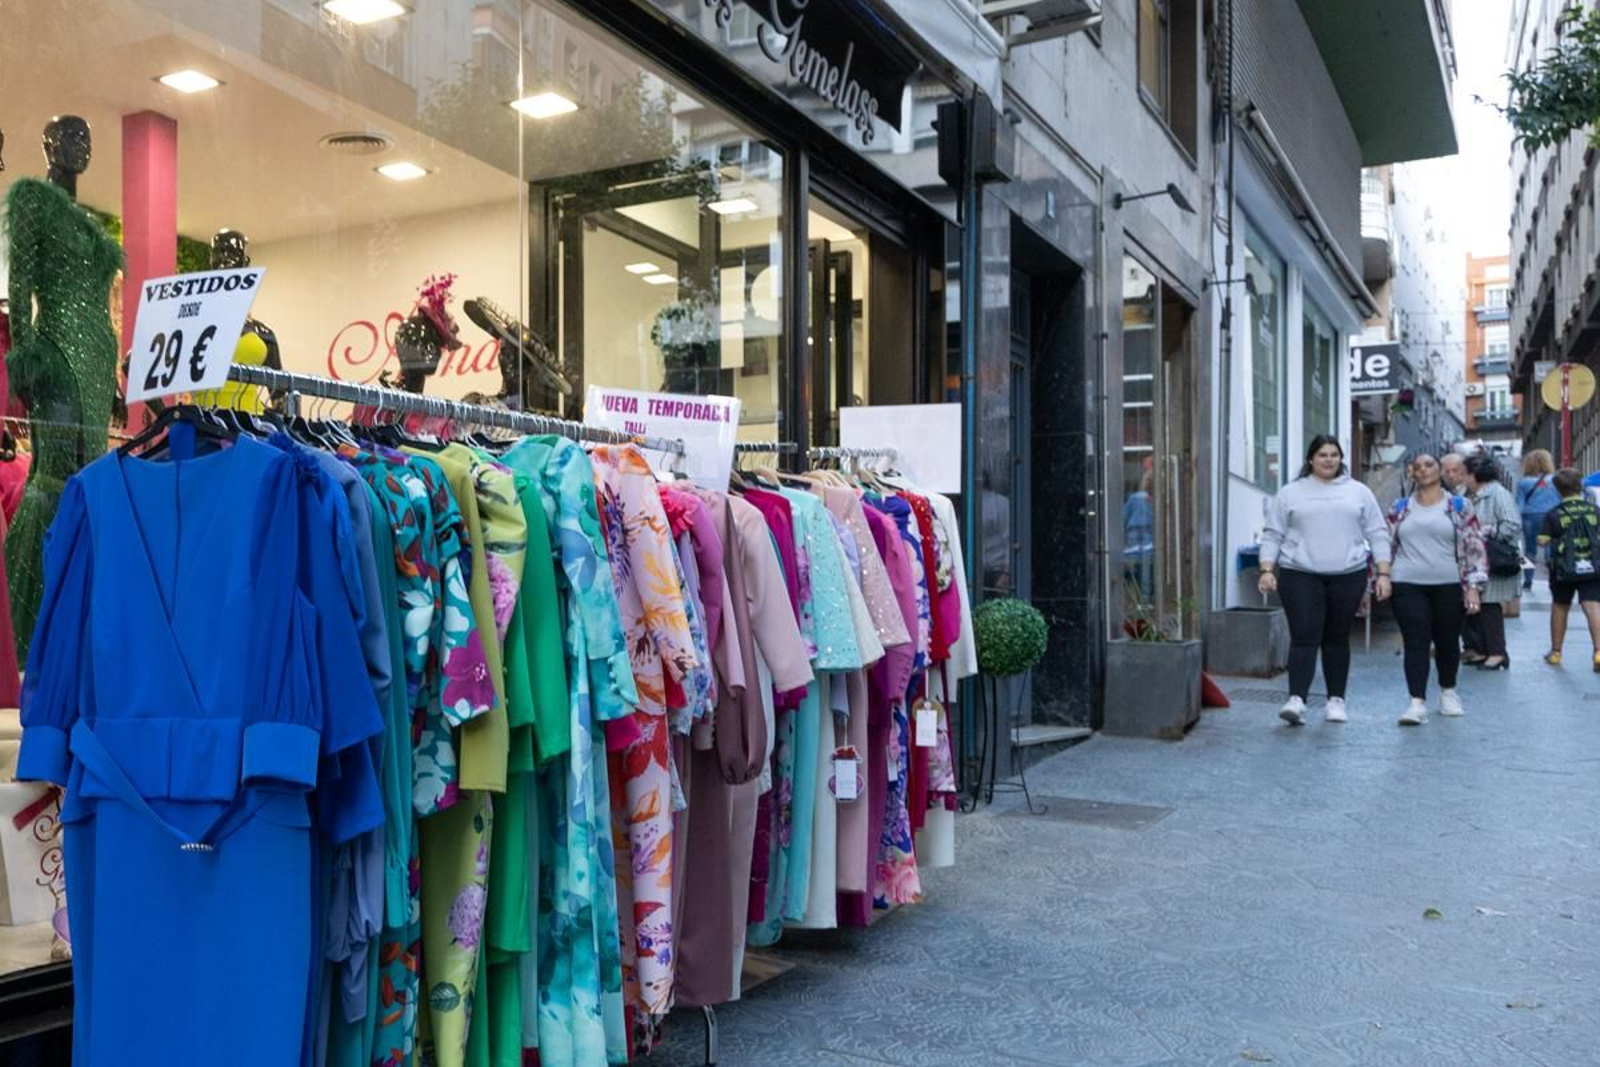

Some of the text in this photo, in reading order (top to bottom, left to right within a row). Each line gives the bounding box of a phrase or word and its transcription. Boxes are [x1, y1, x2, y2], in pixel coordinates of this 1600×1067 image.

[145, 272, 259, 303] VESTIDOS
[177, 301, 203, 319] DESDE
[143, 324, 218, 391] 29 €
